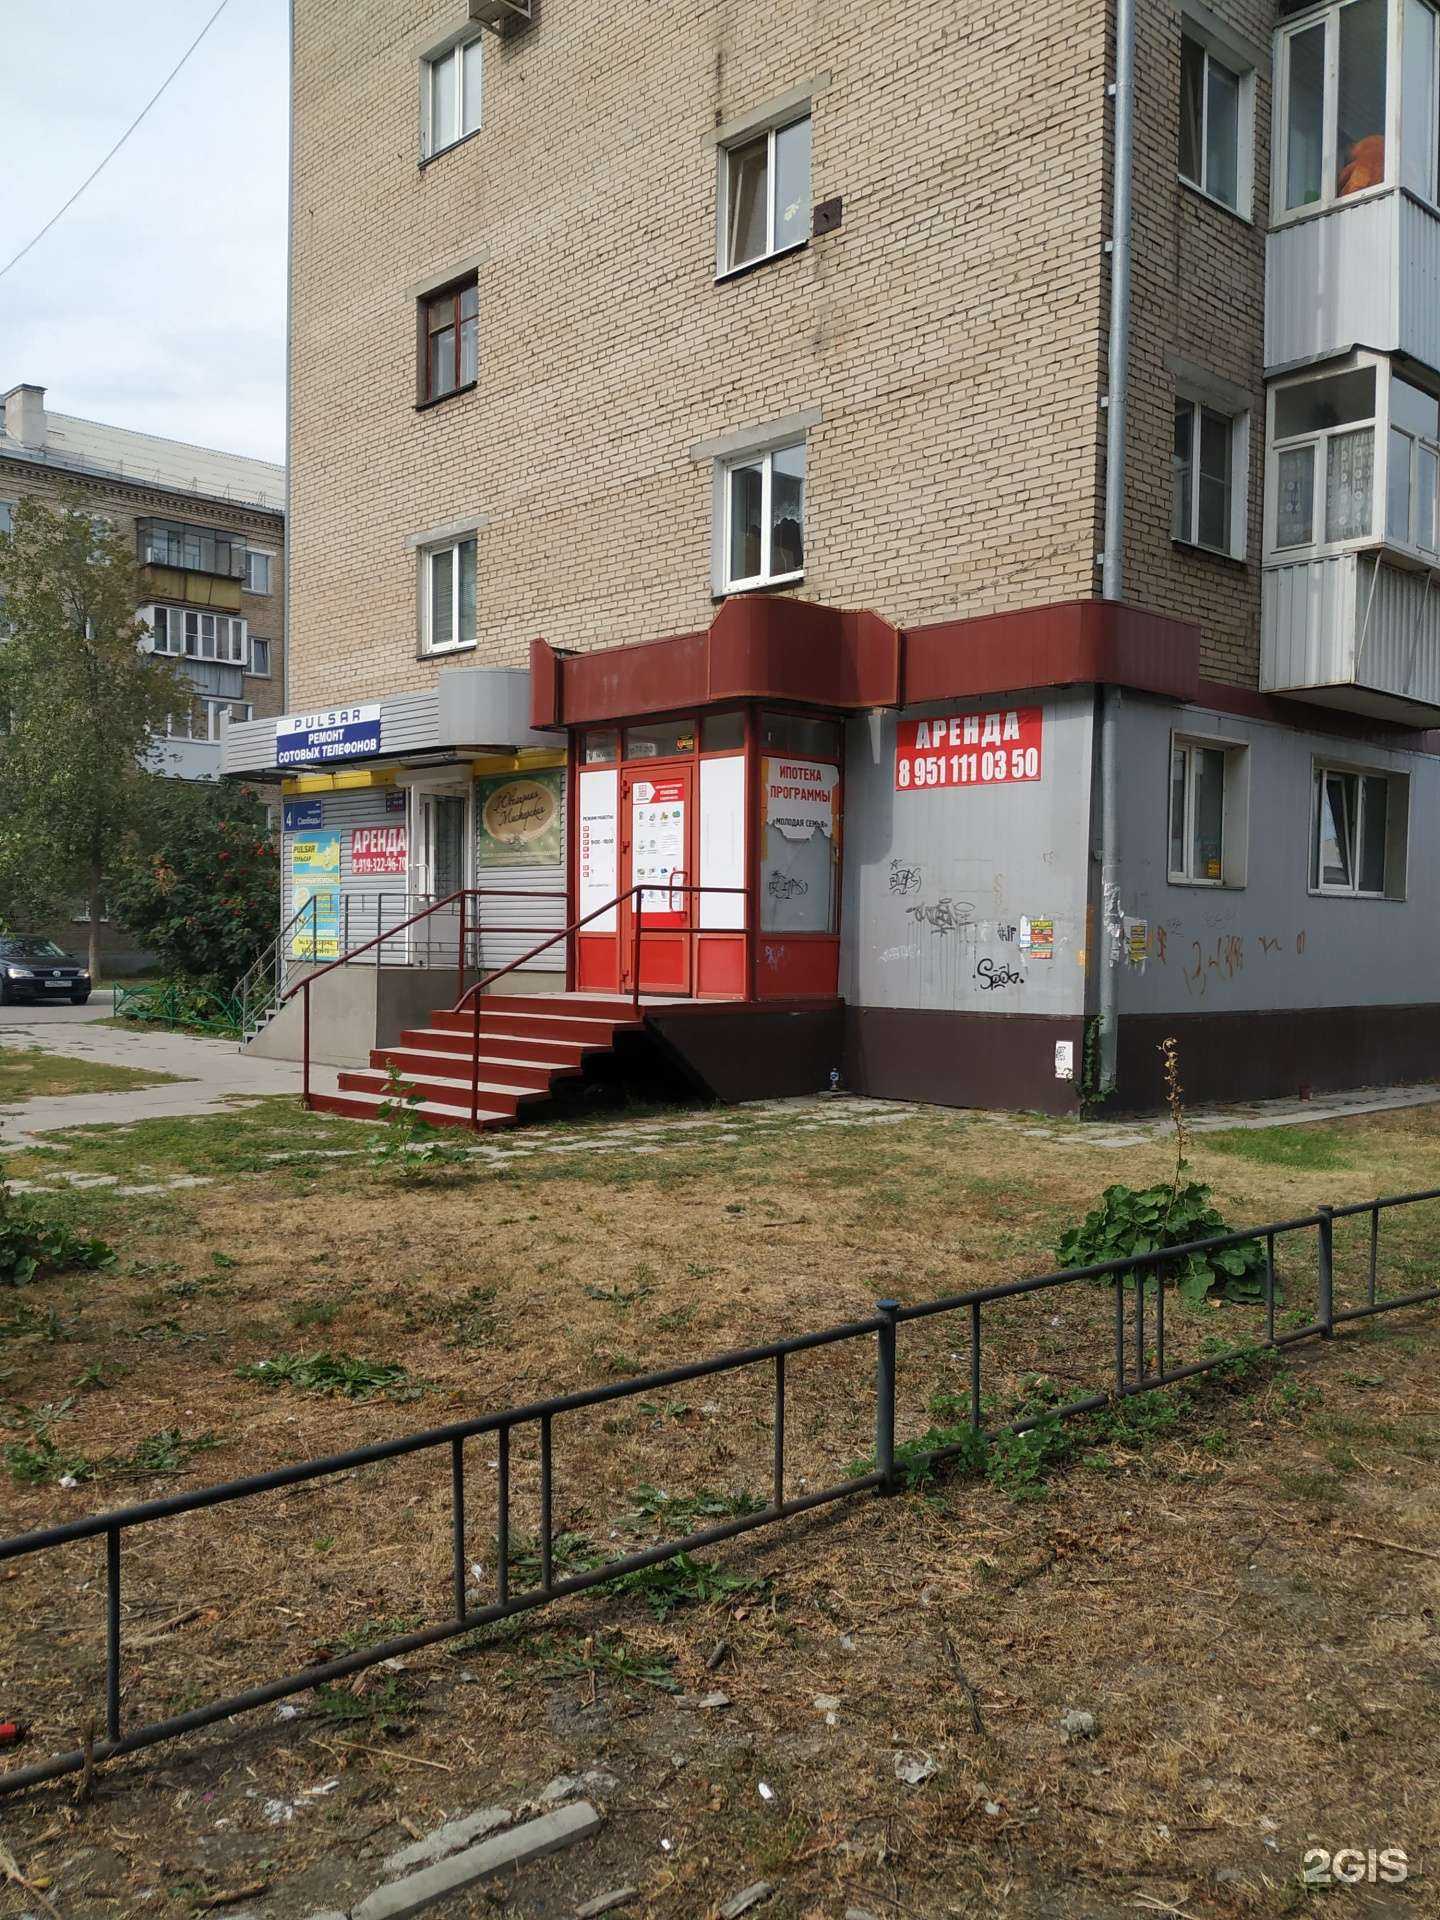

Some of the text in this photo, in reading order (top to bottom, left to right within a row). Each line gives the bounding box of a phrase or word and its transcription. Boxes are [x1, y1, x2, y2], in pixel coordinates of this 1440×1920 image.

[294, 709, 361, 731] PULSAR
[915, 711, 1020, 749] АРЕНДА
[308, 729, 345, 746] РЕМОНТ
[278, 738, 377, 763] СОТОВЫХ ТЕЛЕФОНОВ
[779, 765, 822, 782] ИПОТЕКА
[898, 747, 1039, 787] 8 951 111 03 50
[770, 785, 831, 803] ПРОГРАММЫ
[286, 811, 292, 827] 4
[353, 828, 406, 856] АРЕНДА
